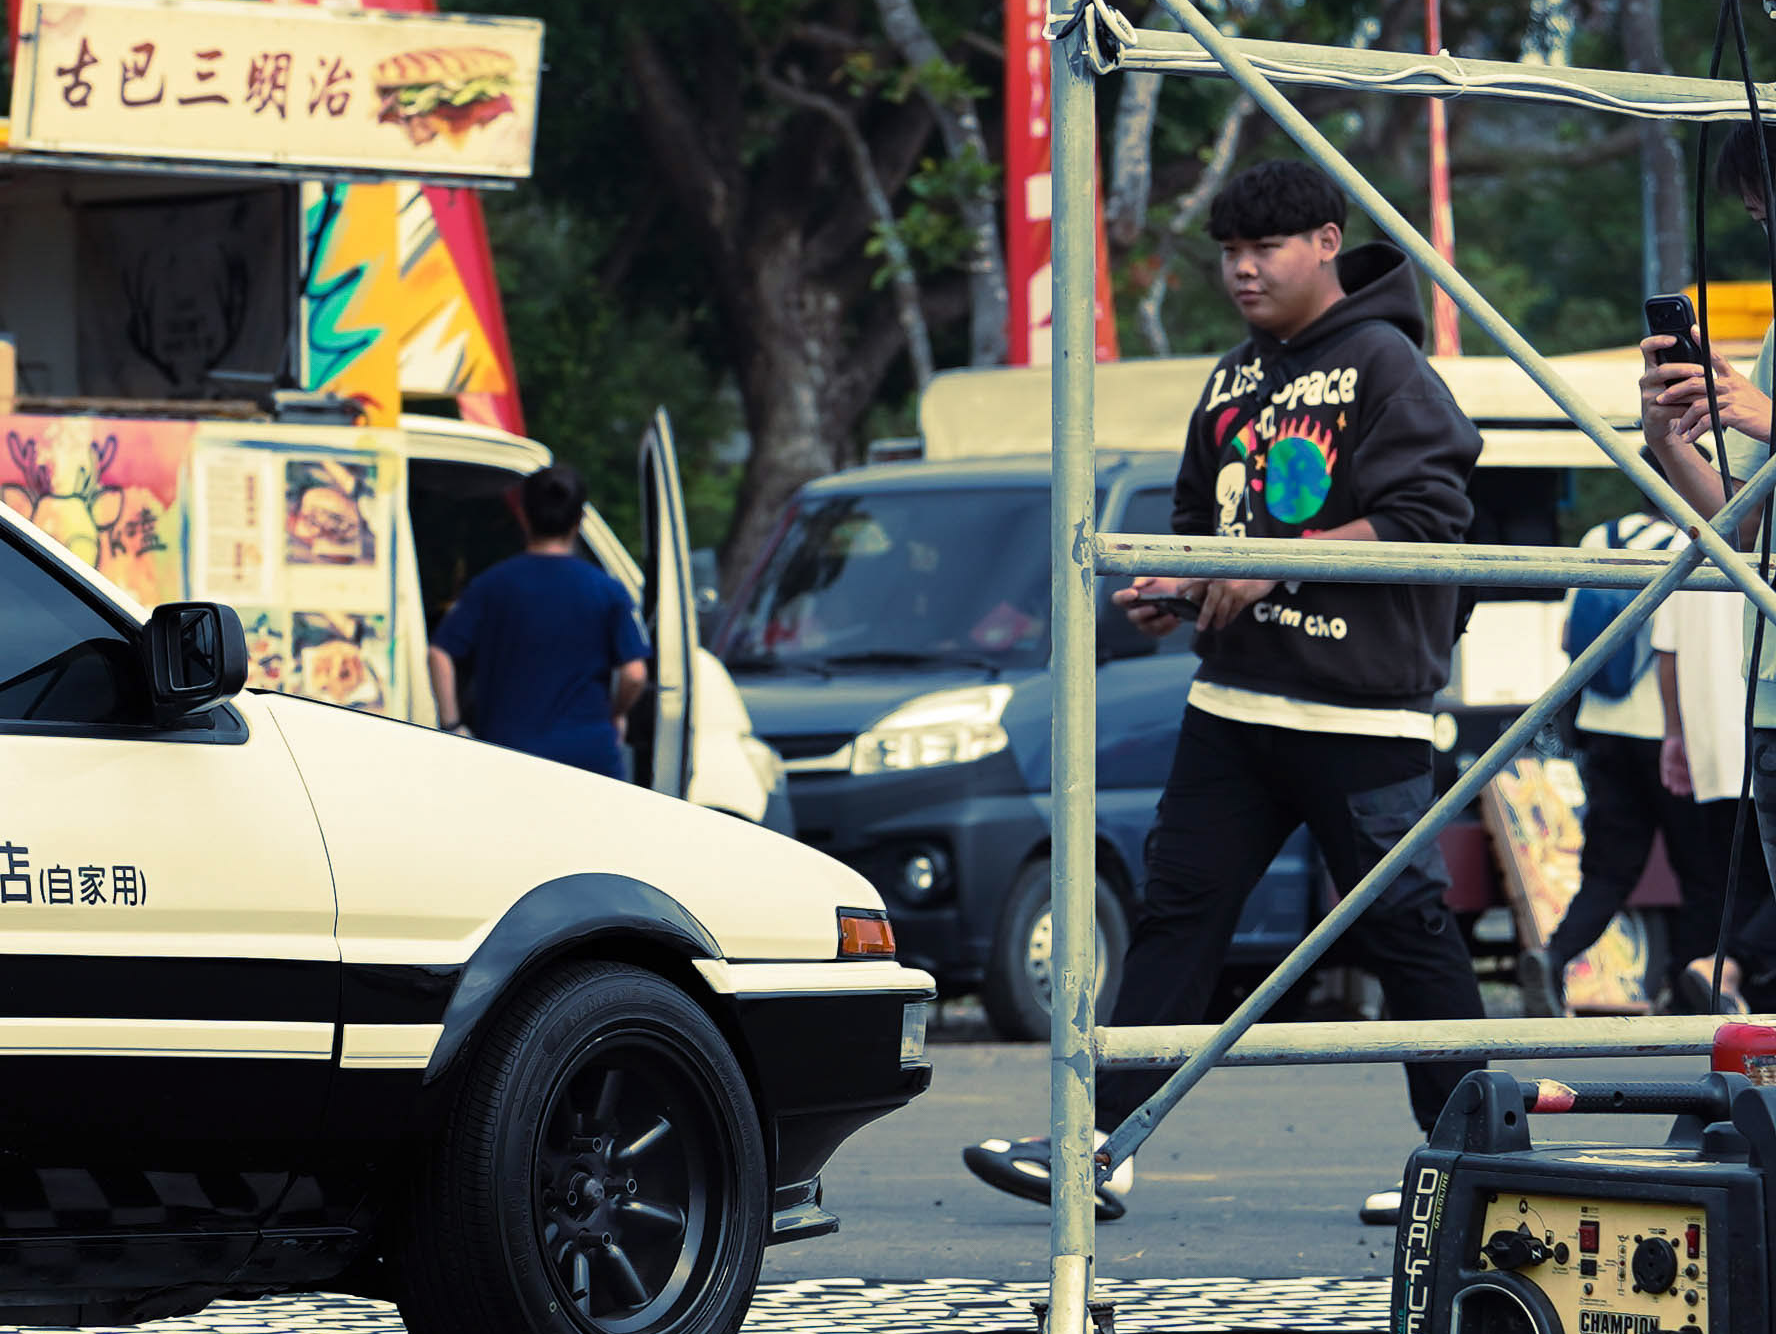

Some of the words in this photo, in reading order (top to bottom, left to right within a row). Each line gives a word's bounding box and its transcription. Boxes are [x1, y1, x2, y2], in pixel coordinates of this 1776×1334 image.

[56, 37, 352, 119] 古巴三明治
[1434, 1172, 1449, 1230] GASOLINE
